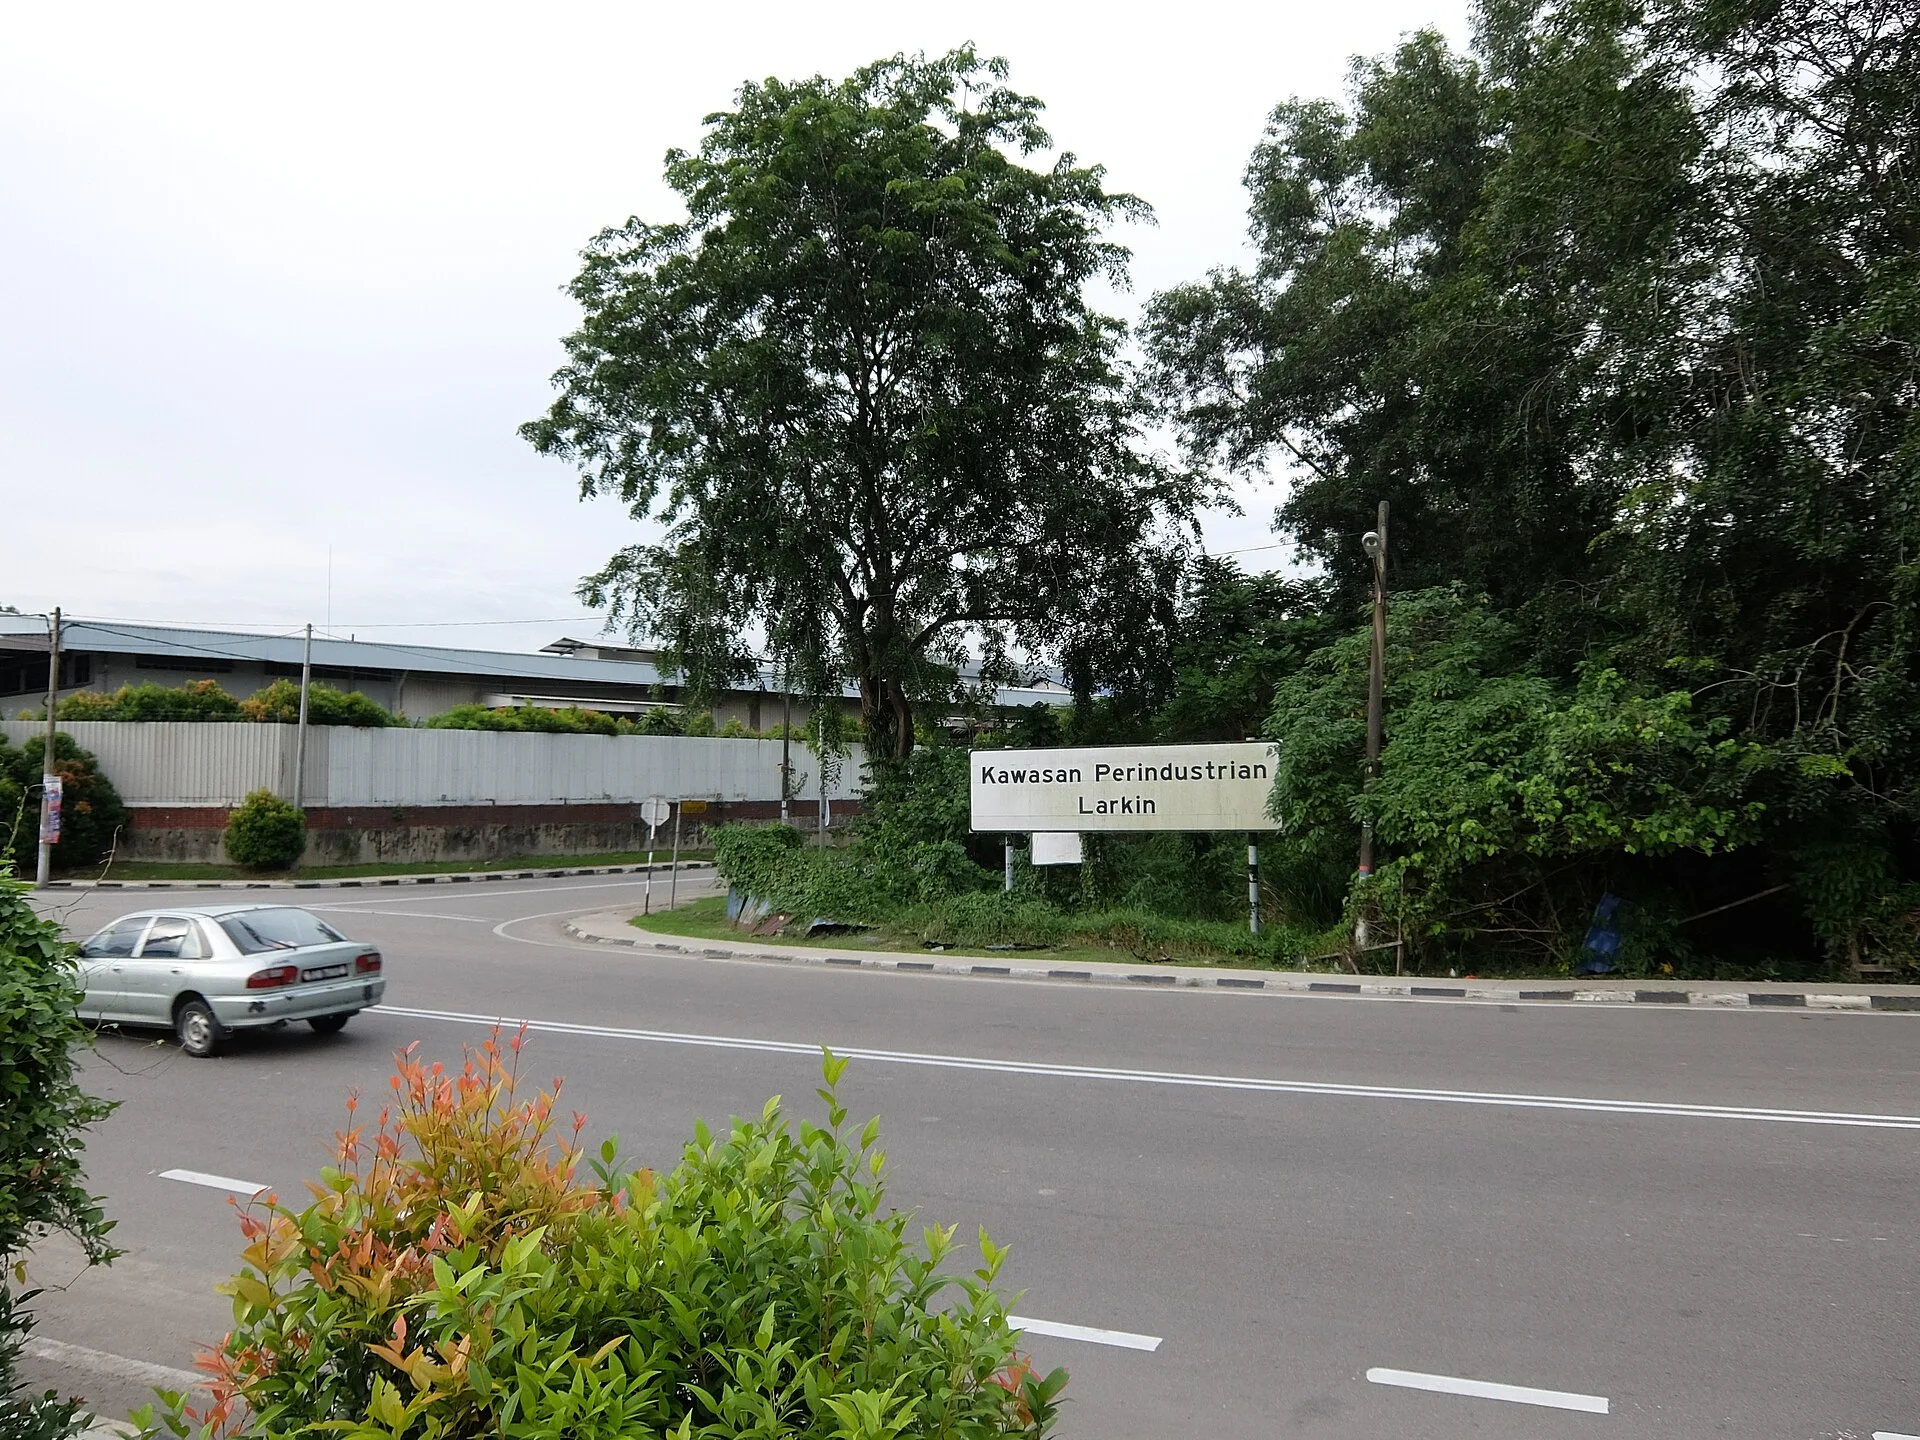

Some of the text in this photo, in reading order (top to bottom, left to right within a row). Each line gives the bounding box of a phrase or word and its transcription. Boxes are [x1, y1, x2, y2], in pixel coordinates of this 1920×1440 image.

[982, 760, 1268, 785] Kawasan Perindustrian
[1079, 795, 1156, 815] Larkin
